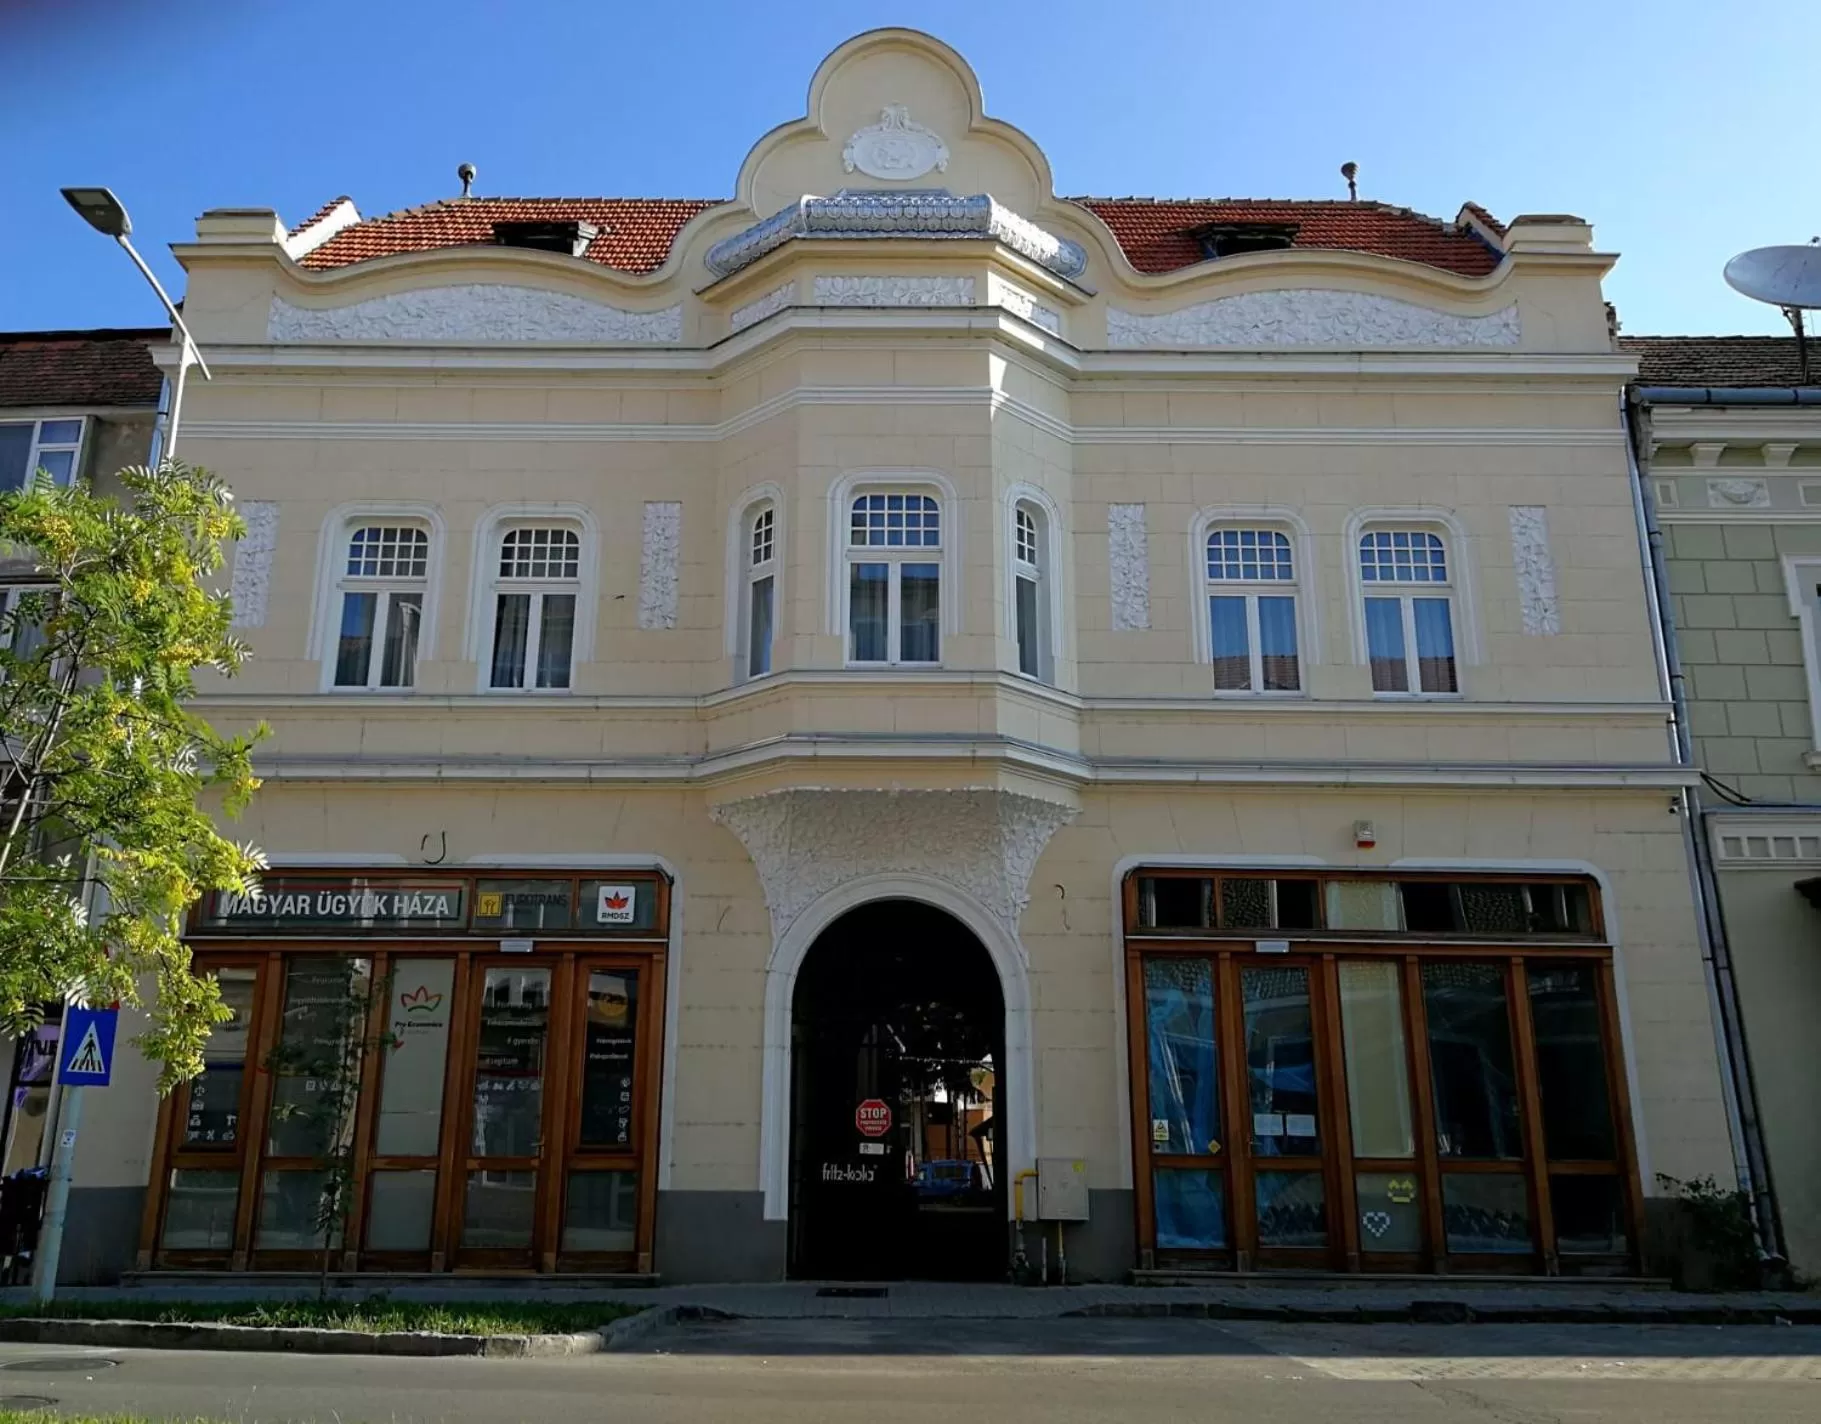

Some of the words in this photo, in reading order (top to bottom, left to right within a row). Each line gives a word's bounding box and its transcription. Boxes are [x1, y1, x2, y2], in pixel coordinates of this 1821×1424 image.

[219, 893, 310, 915] MAGYAR
[394, 891, 449, 915] HÁZA
[601, 912, 630, 920] RMDSZ
[860, 1107, 887, 1118] STOP
